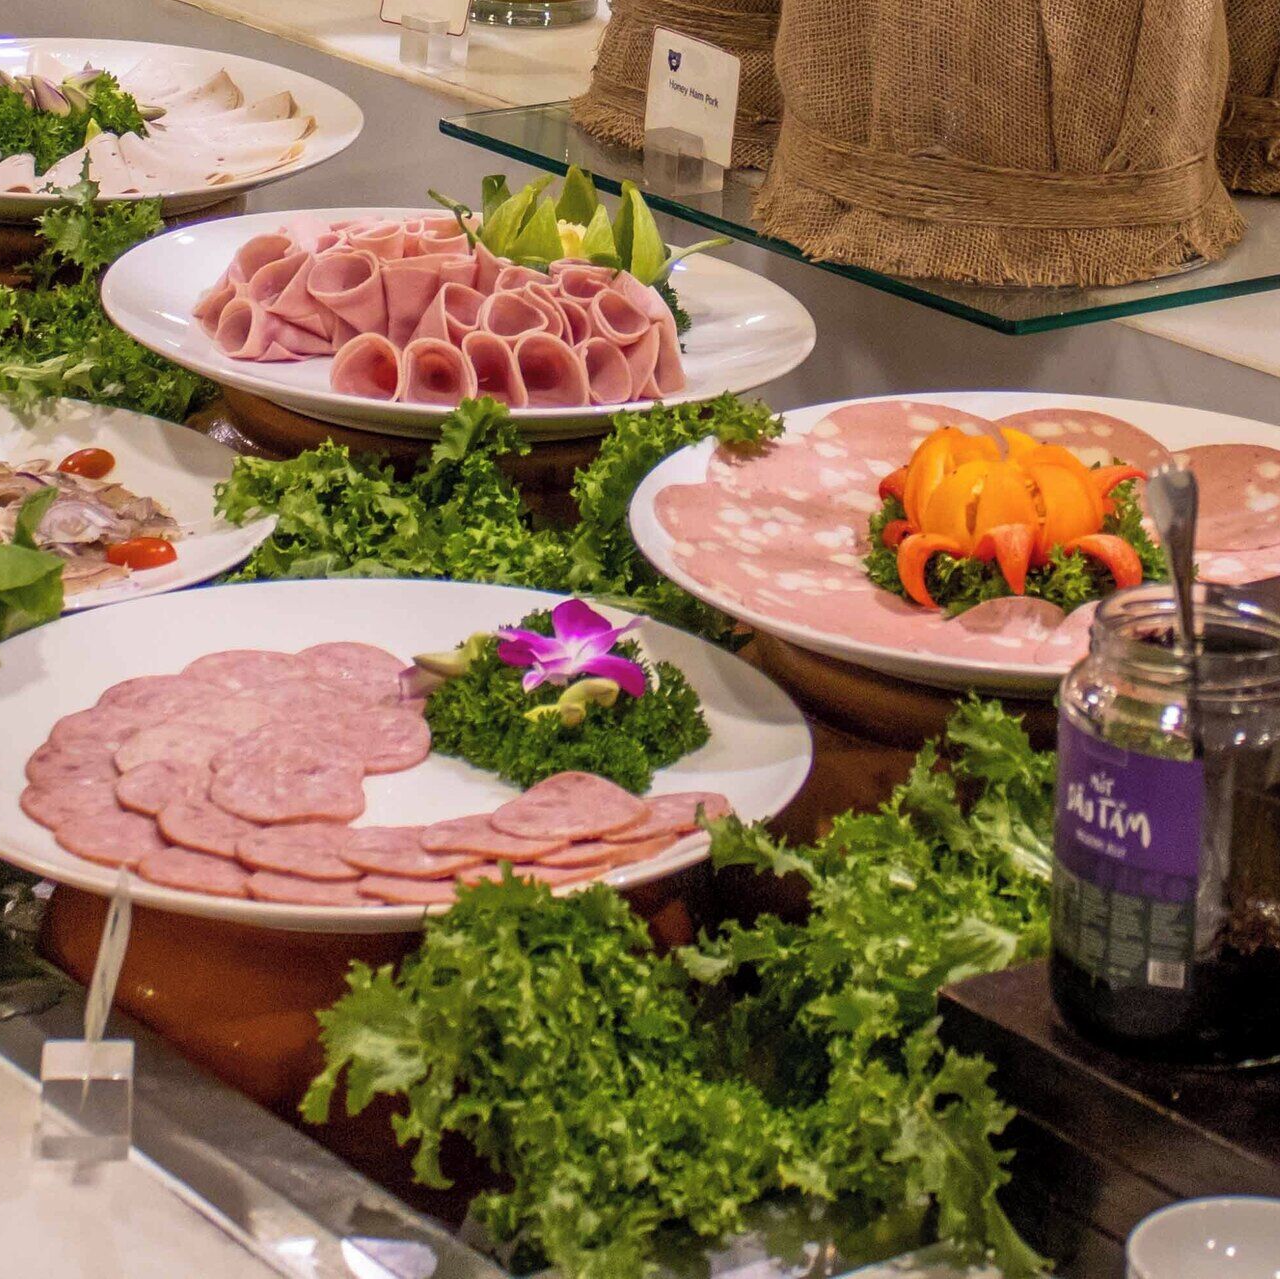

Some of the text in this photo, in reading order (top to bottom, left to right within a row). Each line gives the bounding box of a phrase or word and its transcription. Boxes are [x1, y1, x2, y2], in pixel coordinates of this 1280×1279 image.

[669, 79, 719, 108] Honey Ham Pork
